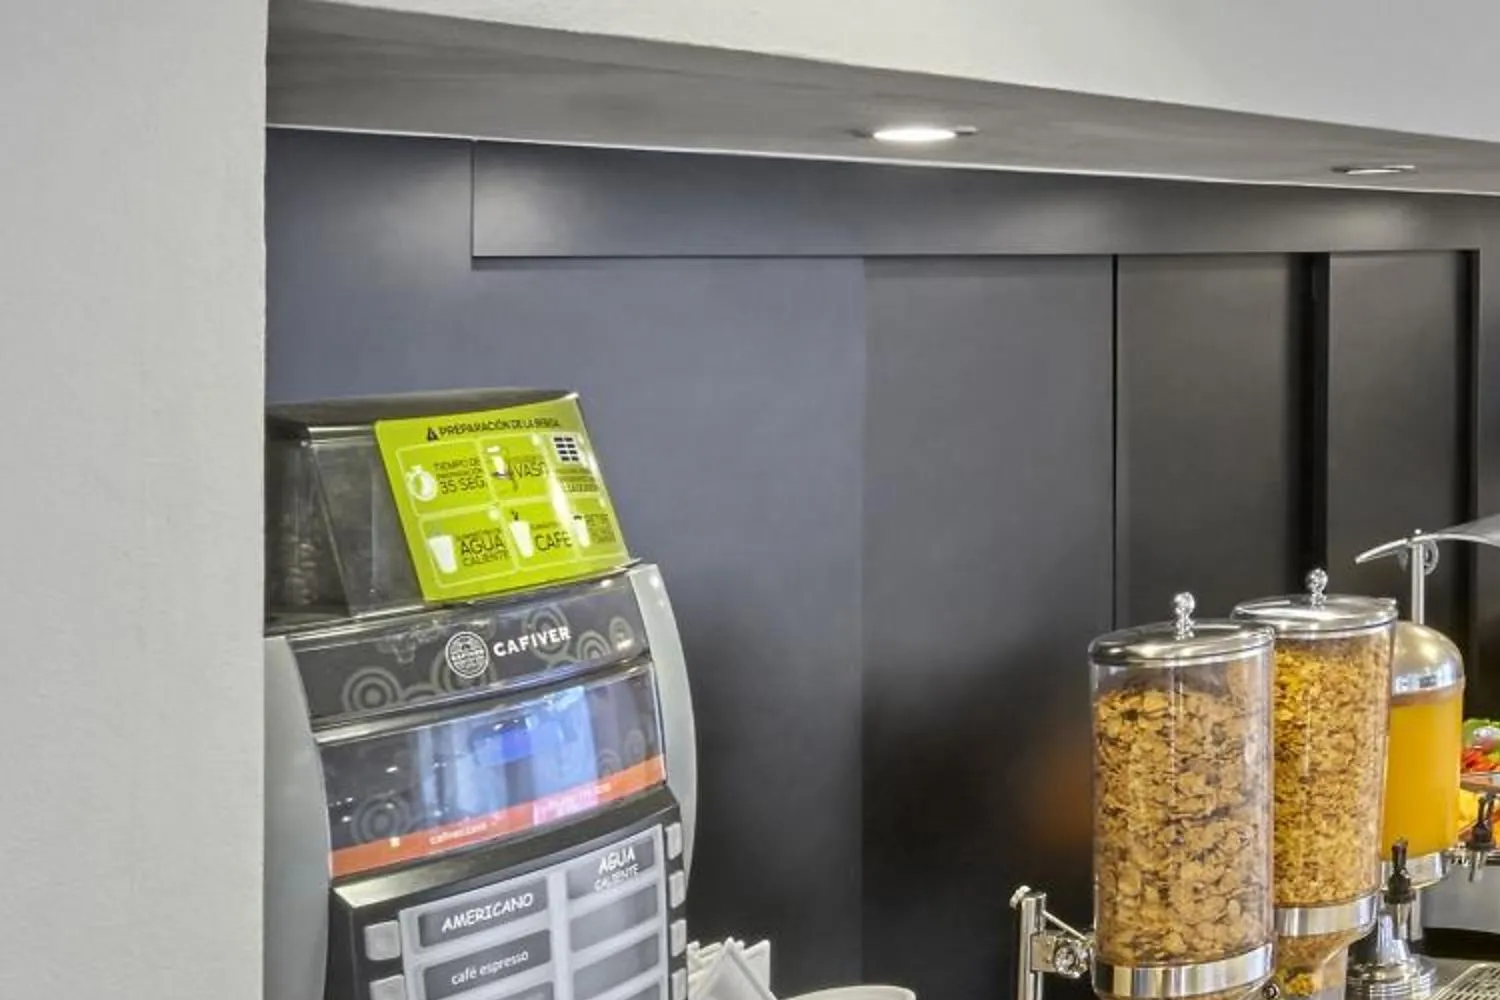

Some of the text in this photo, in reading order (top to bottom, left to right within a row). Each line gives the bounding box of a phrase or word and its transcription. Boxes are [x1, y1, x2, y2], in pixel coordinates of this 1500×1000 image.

[440, 479, 457, 495] 35
[460, 534, 505, 555] AGUA
[492, 625, 572, 659] CAFIVER
[598, 846, 636, 876] AGUA
[441, 892, 534, 934] AMERICANO
[451, 950, 529, 986] café espresso
